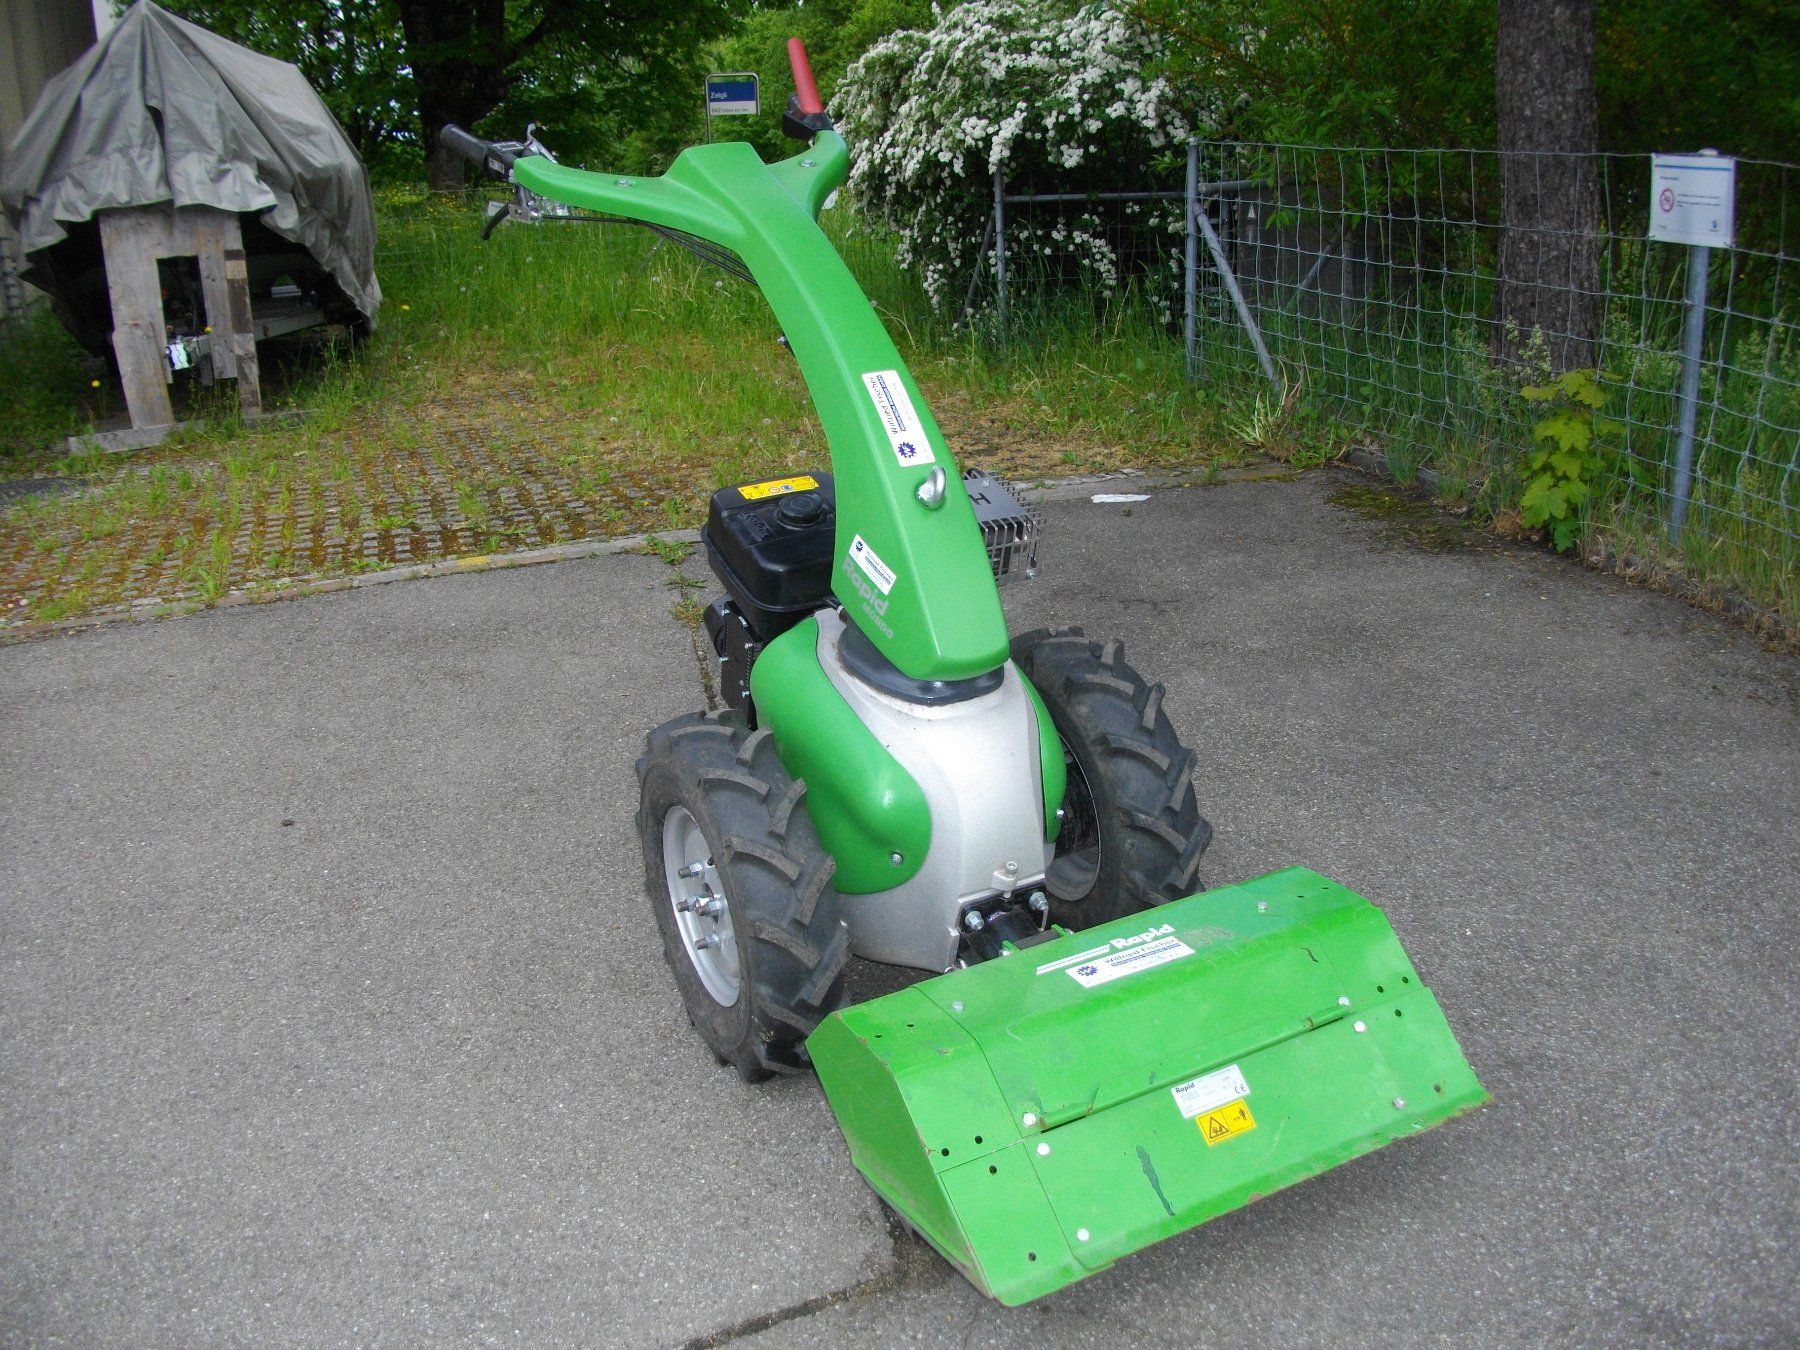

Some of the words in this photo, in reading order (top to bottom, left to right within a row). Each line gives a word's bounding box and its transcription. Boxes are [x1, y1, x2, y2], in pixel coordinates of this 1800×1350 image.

[842, 556, 889, 617] Rapid
[1109, 924, 1175, 948] Rapid
[1175, 1082, 1195, 1094] Rapid
